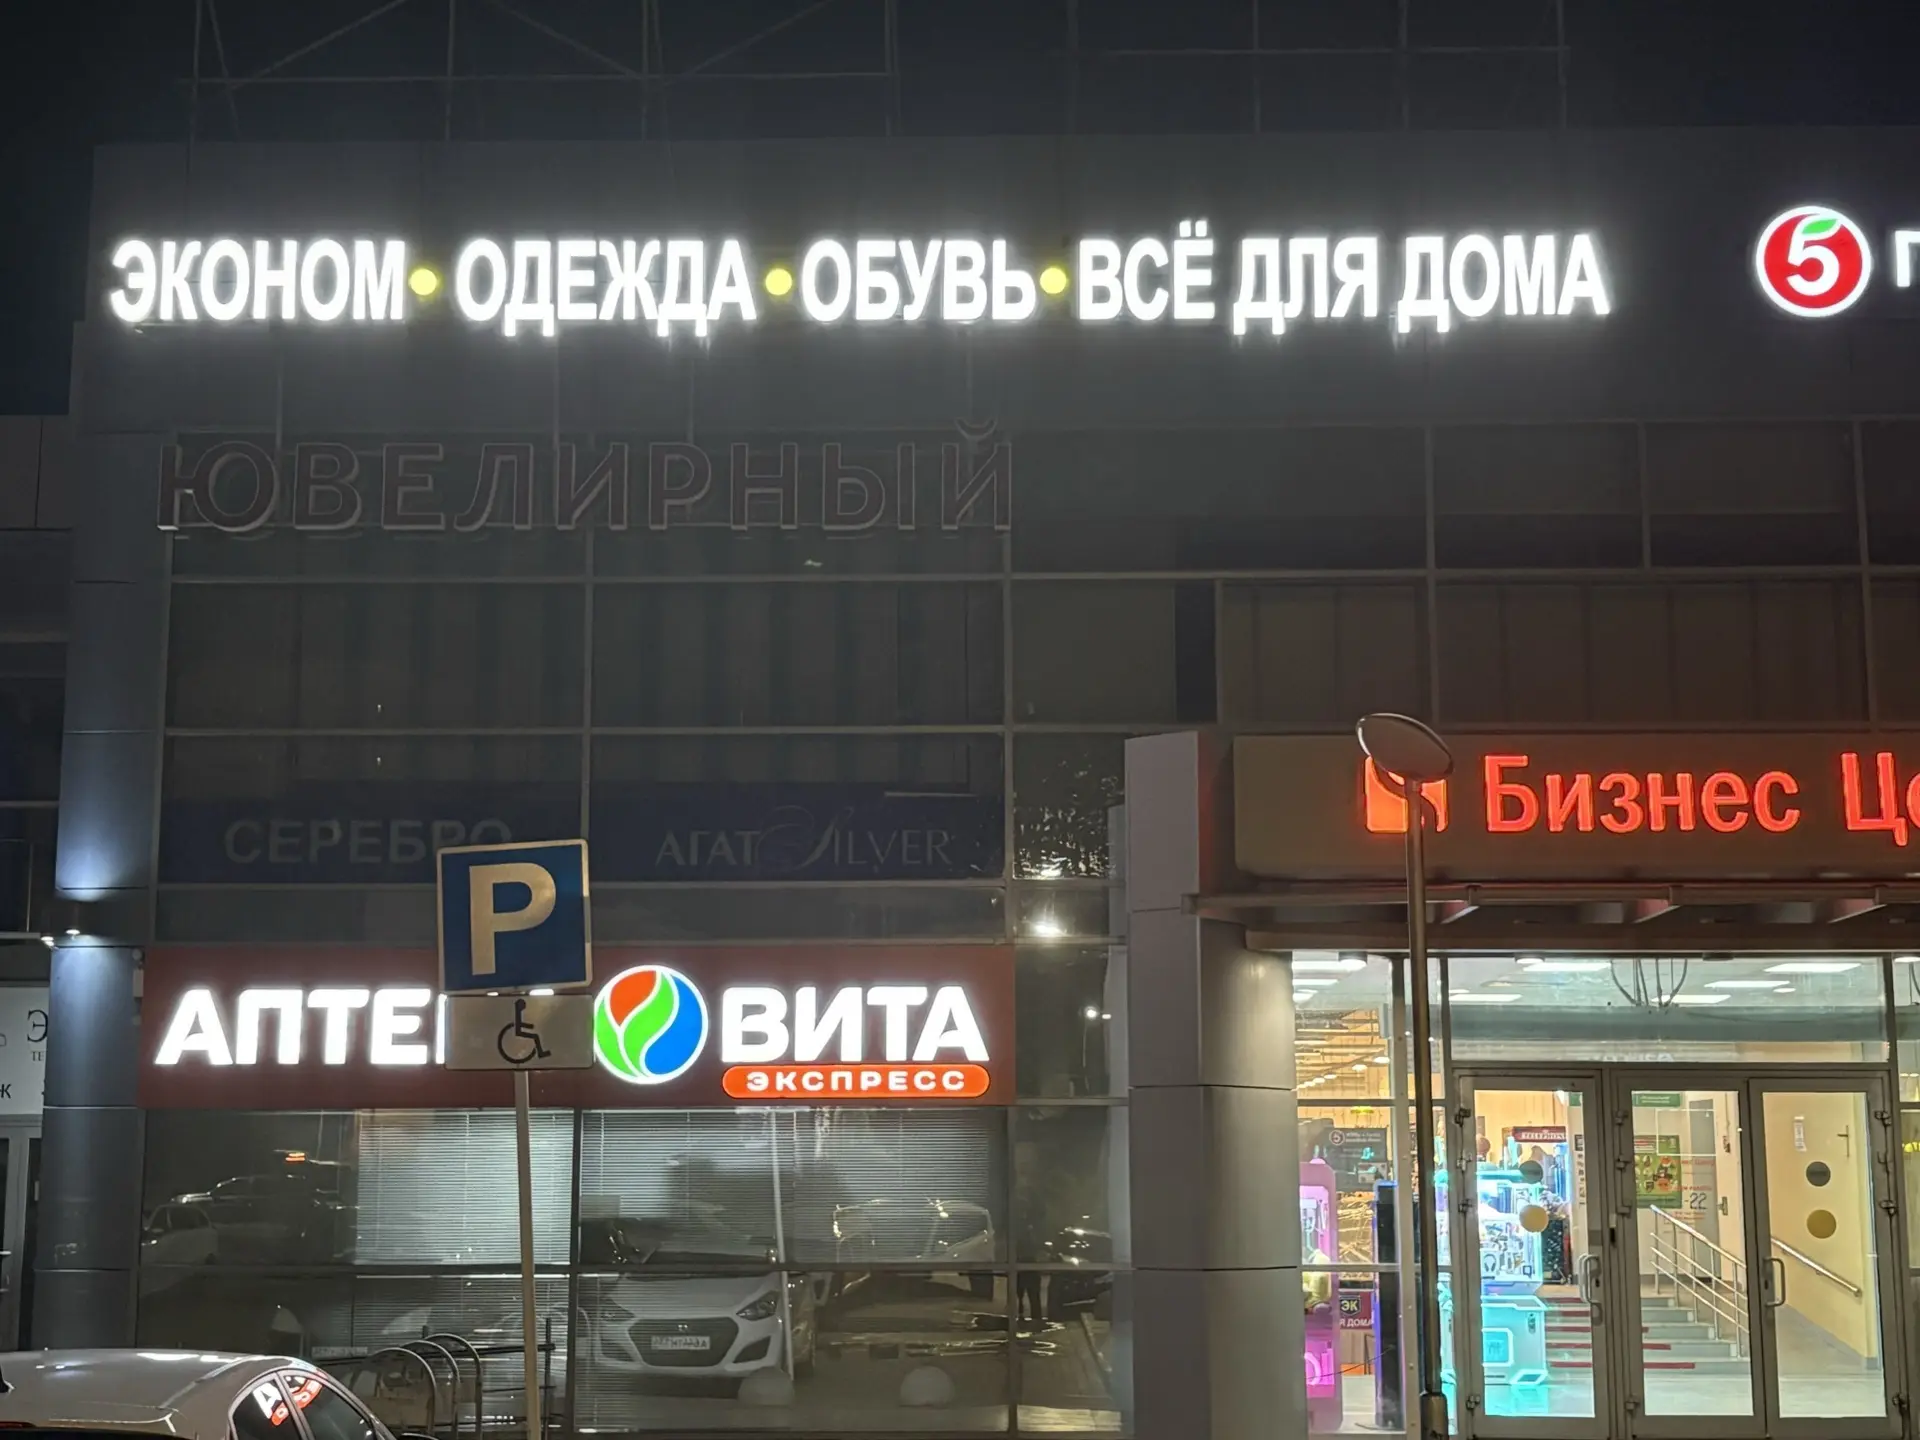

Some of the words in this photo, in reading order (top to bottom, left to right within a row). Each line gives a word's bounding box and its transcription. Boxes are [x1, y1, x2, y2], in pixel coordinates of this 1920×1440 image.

[110, 238, 406, 323] ЭКОНОМ
[455, 238, 758, 337] ОДЕЖДА
[800, 239, 1037, 324] ОБУВЬ
[1078, 220, 1216, 321] ВСЁ
[1232, 236, 1379, 335] ДЛЯ
[1397, 233, 1611, 333] ДОМА
[157, 417, 1012, 532] ЮВЕЛИРНЫЙ
[1484, 754, 1800, 833] Бизнес
[655, 829, 760, 867] АГАТ
[469, 862, 557, 977] P
[720, 986, 990, 1063] ВИТА
[746, 1070, 965, 1092] ЭКСПРЕСС
